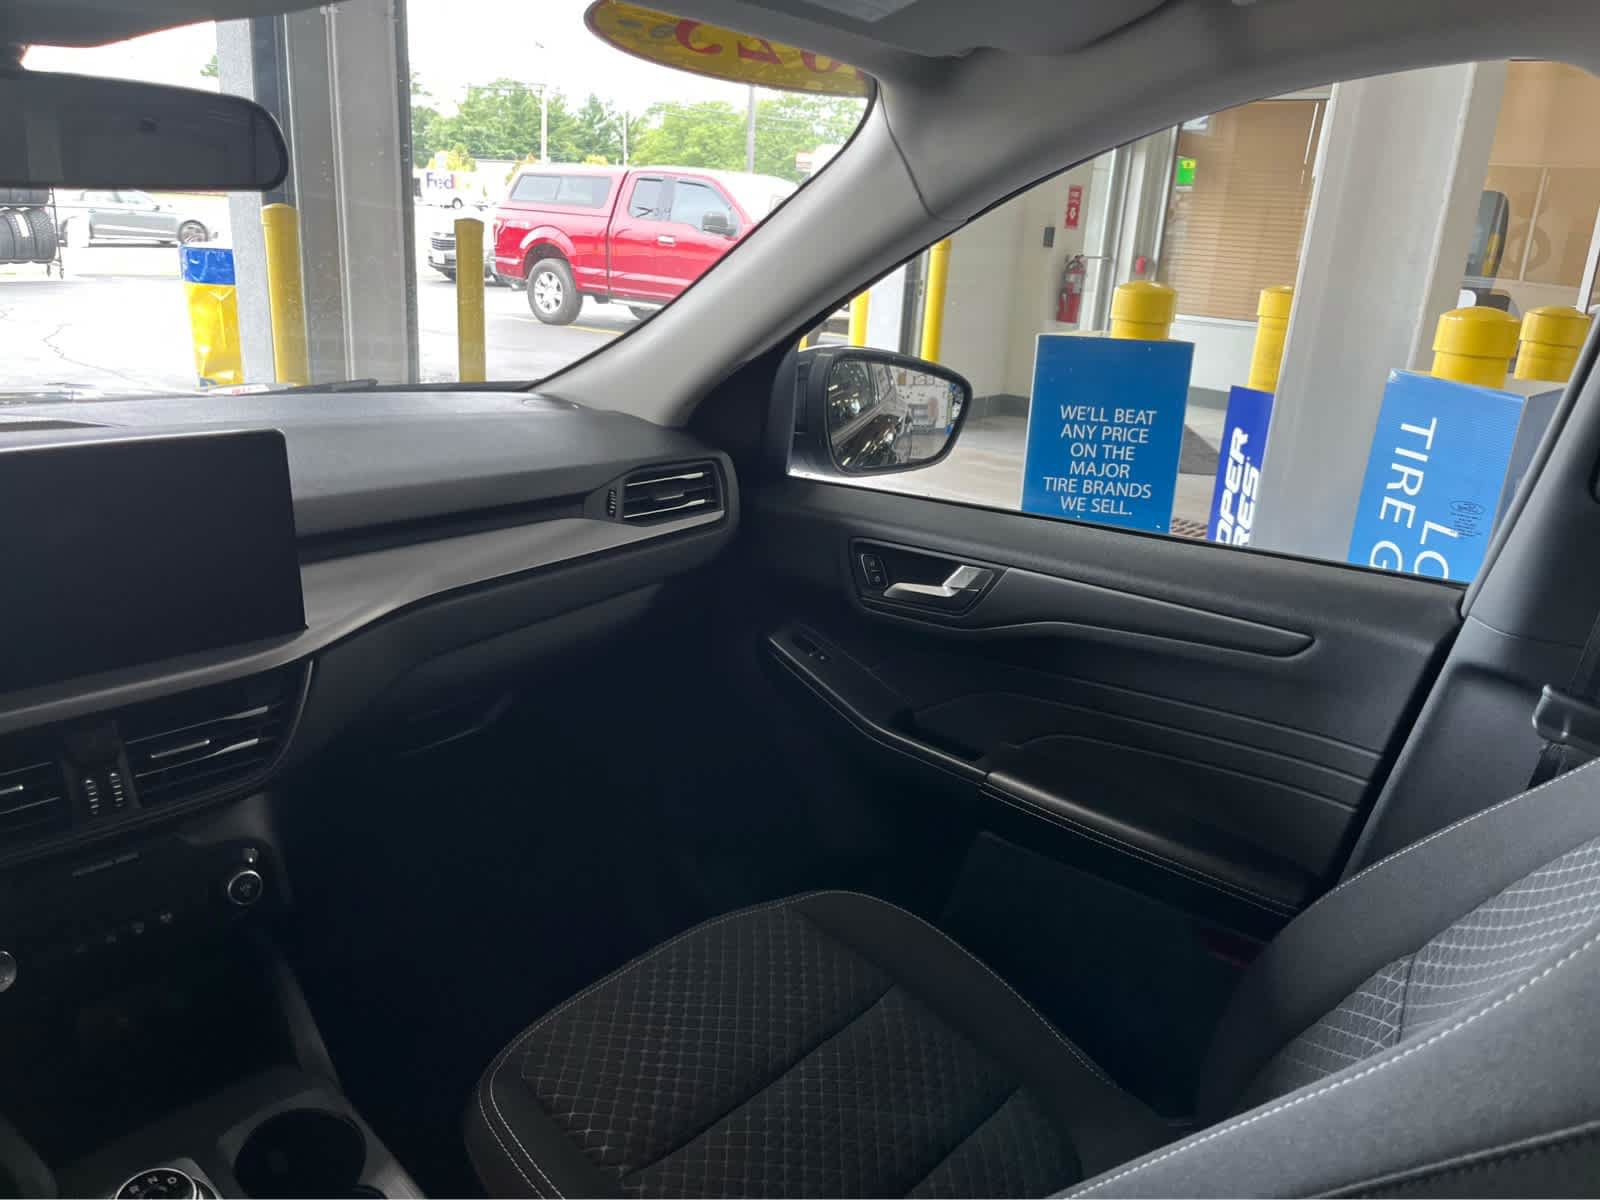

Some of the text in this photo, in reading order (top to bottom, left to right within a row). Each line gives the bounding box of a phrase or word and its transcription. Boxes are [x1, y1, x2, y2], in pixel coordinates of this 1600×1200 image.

[1060, 405, 1157, 425] WE'LL BEAT
[1060, 424, 1149, 444] ANY PRICE
[1070, 442, 1135, 461] ON THE
[1069, 461, 1130, 479] MAJOR
[1378, 416, 1438, 529] TIRE
[1043, 476, 1152, 499] TIRE BRANDS
[1060, 496, 1133, 516] WE SELL.
